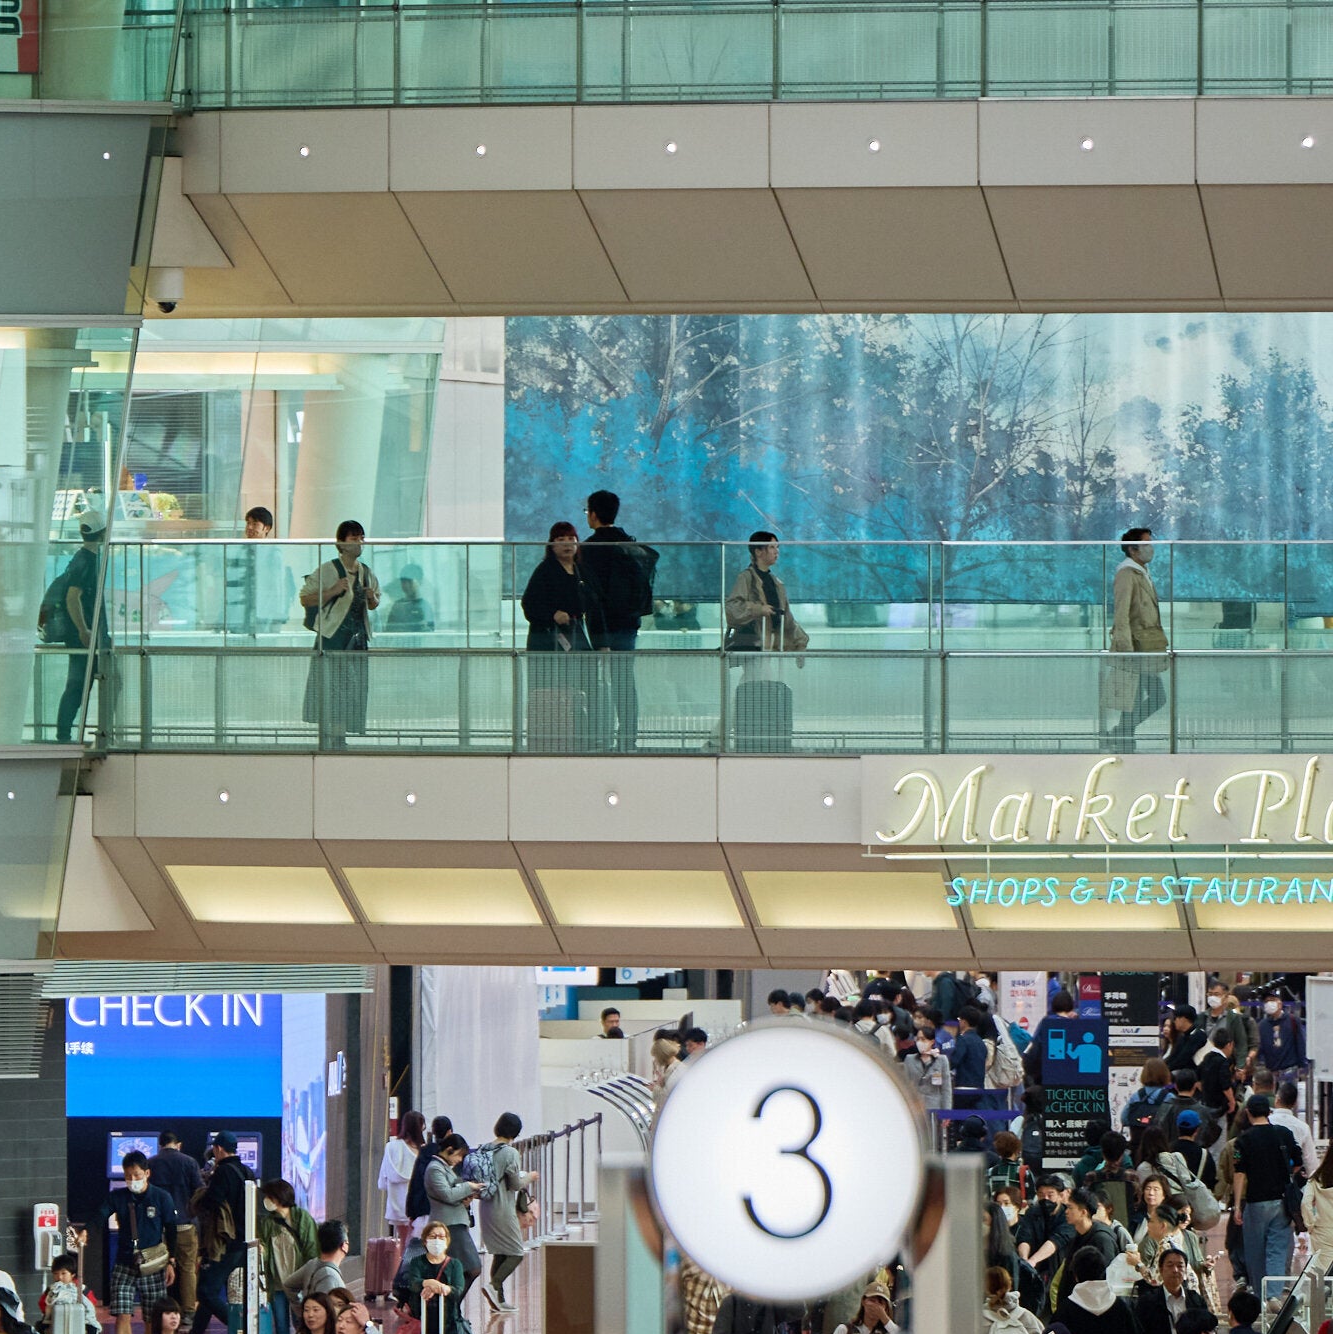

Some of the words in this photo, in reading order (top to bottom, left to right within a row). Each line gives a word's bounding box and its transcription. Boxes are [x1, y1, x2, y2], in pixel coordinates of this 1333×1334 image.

[876, 757, 1190, 843] Market
[946, 877, 1060, 907] SHOPS
[1070, 876, 1095, 905] &
[68, 994, 211, 1027] CHECK
[222, 993, 264, 1027] IN
[1045, 1089, 1105, 1100] TICKETING
[1093, 1101, 1105, 1112] IN
[1045, 1131, 1073, 1139] Ticketing
[741, 1086, 834, 1239] 3
